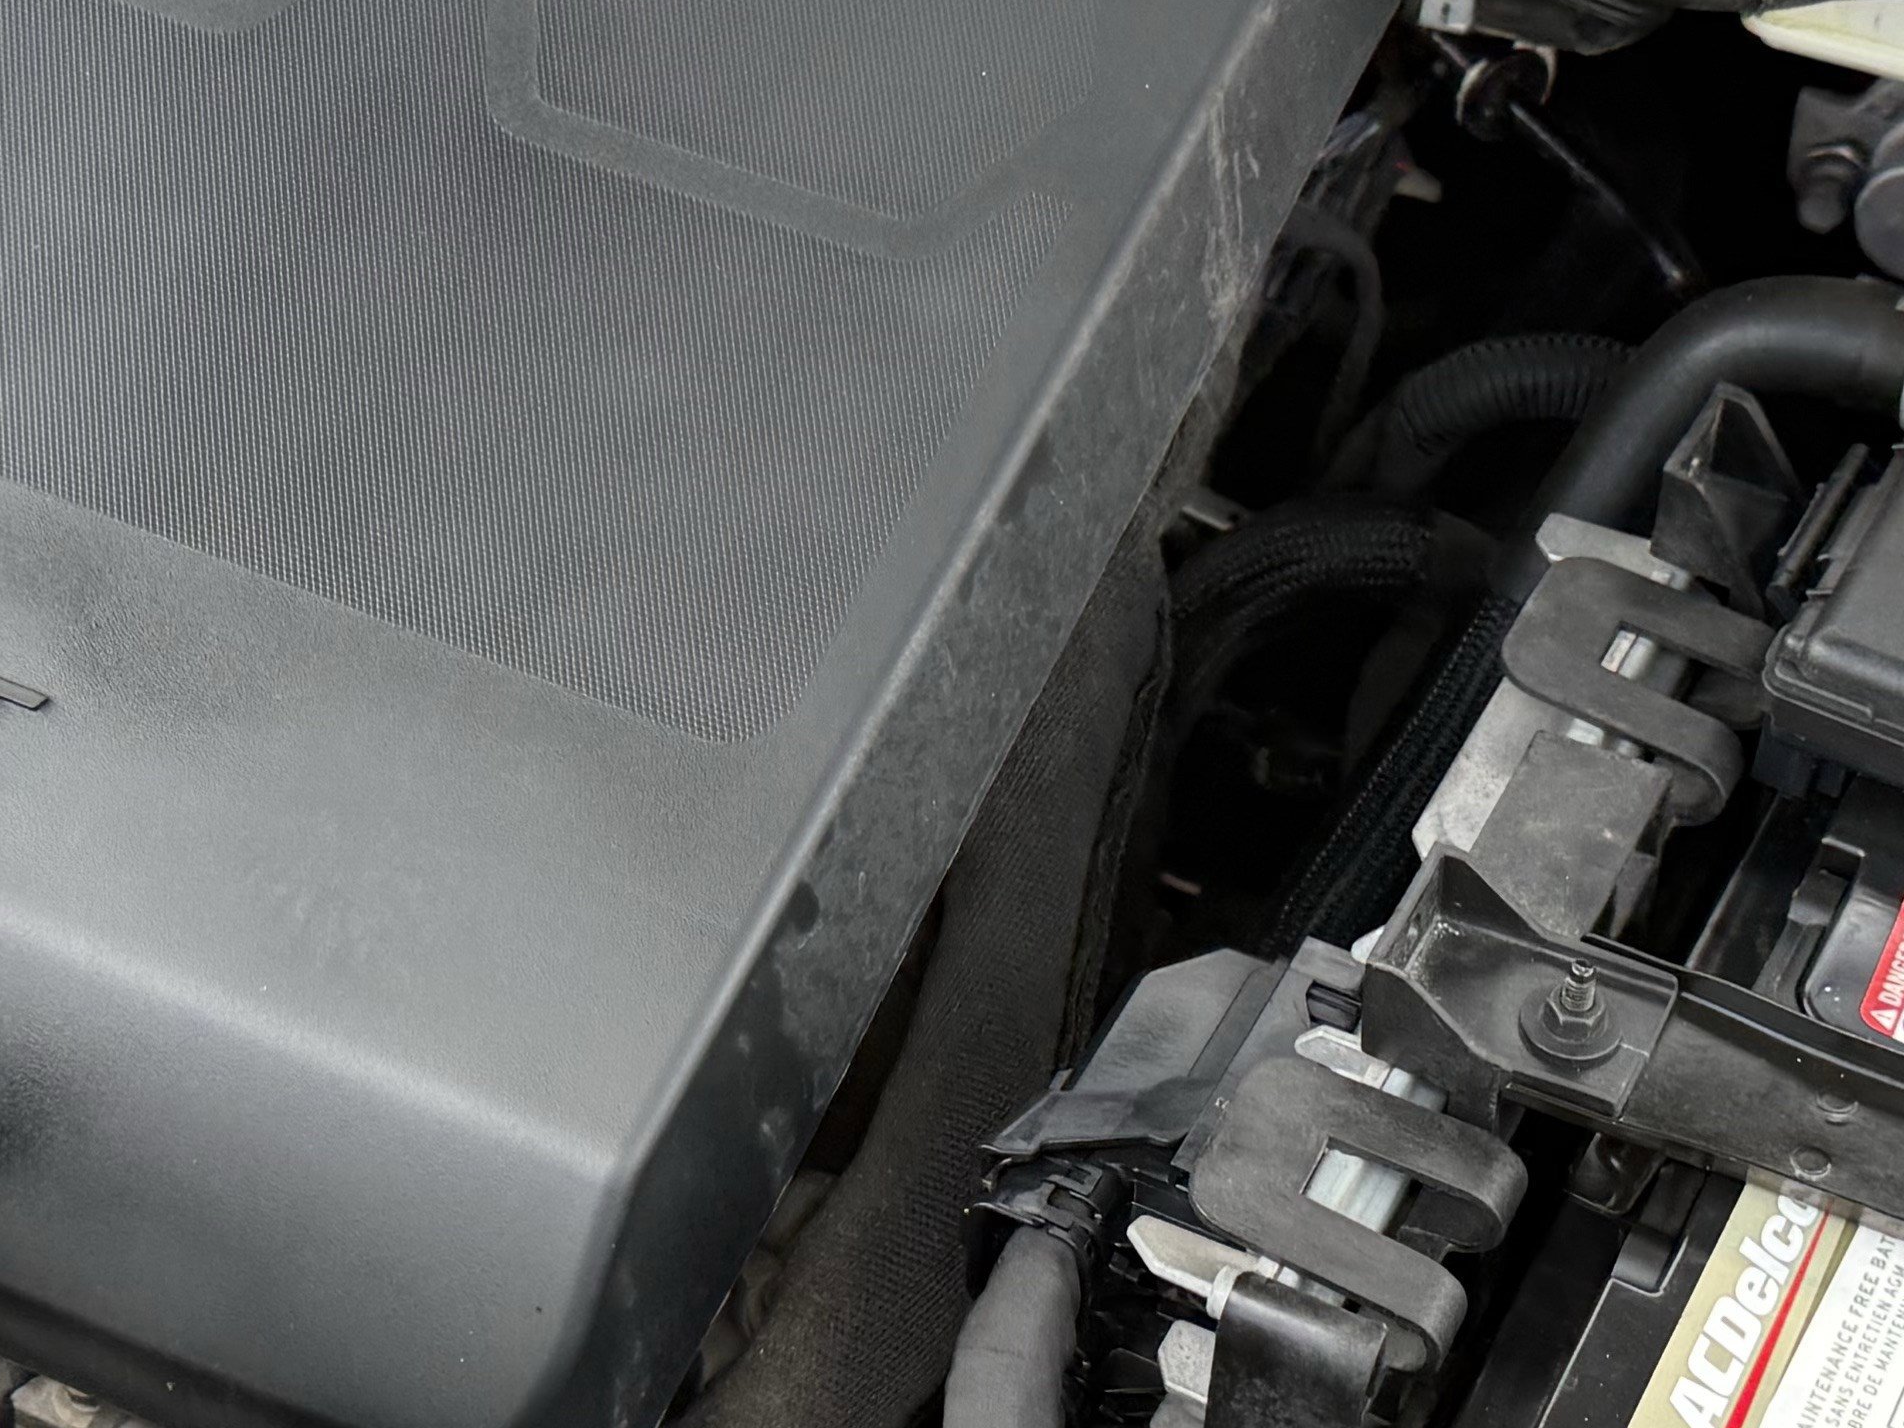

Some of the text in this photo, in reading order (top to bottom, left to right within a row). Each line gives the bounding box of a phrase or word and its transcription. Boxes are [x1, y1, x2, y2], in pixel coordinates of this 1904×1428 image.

[1846, 1270, 1880, 1318] FREE
[1823, 1383, 1855, 1428] SANS
[1843, 1297, 1892, 1384] ENTRETIEN
[1861, 1373, 1883, 1397] DE
